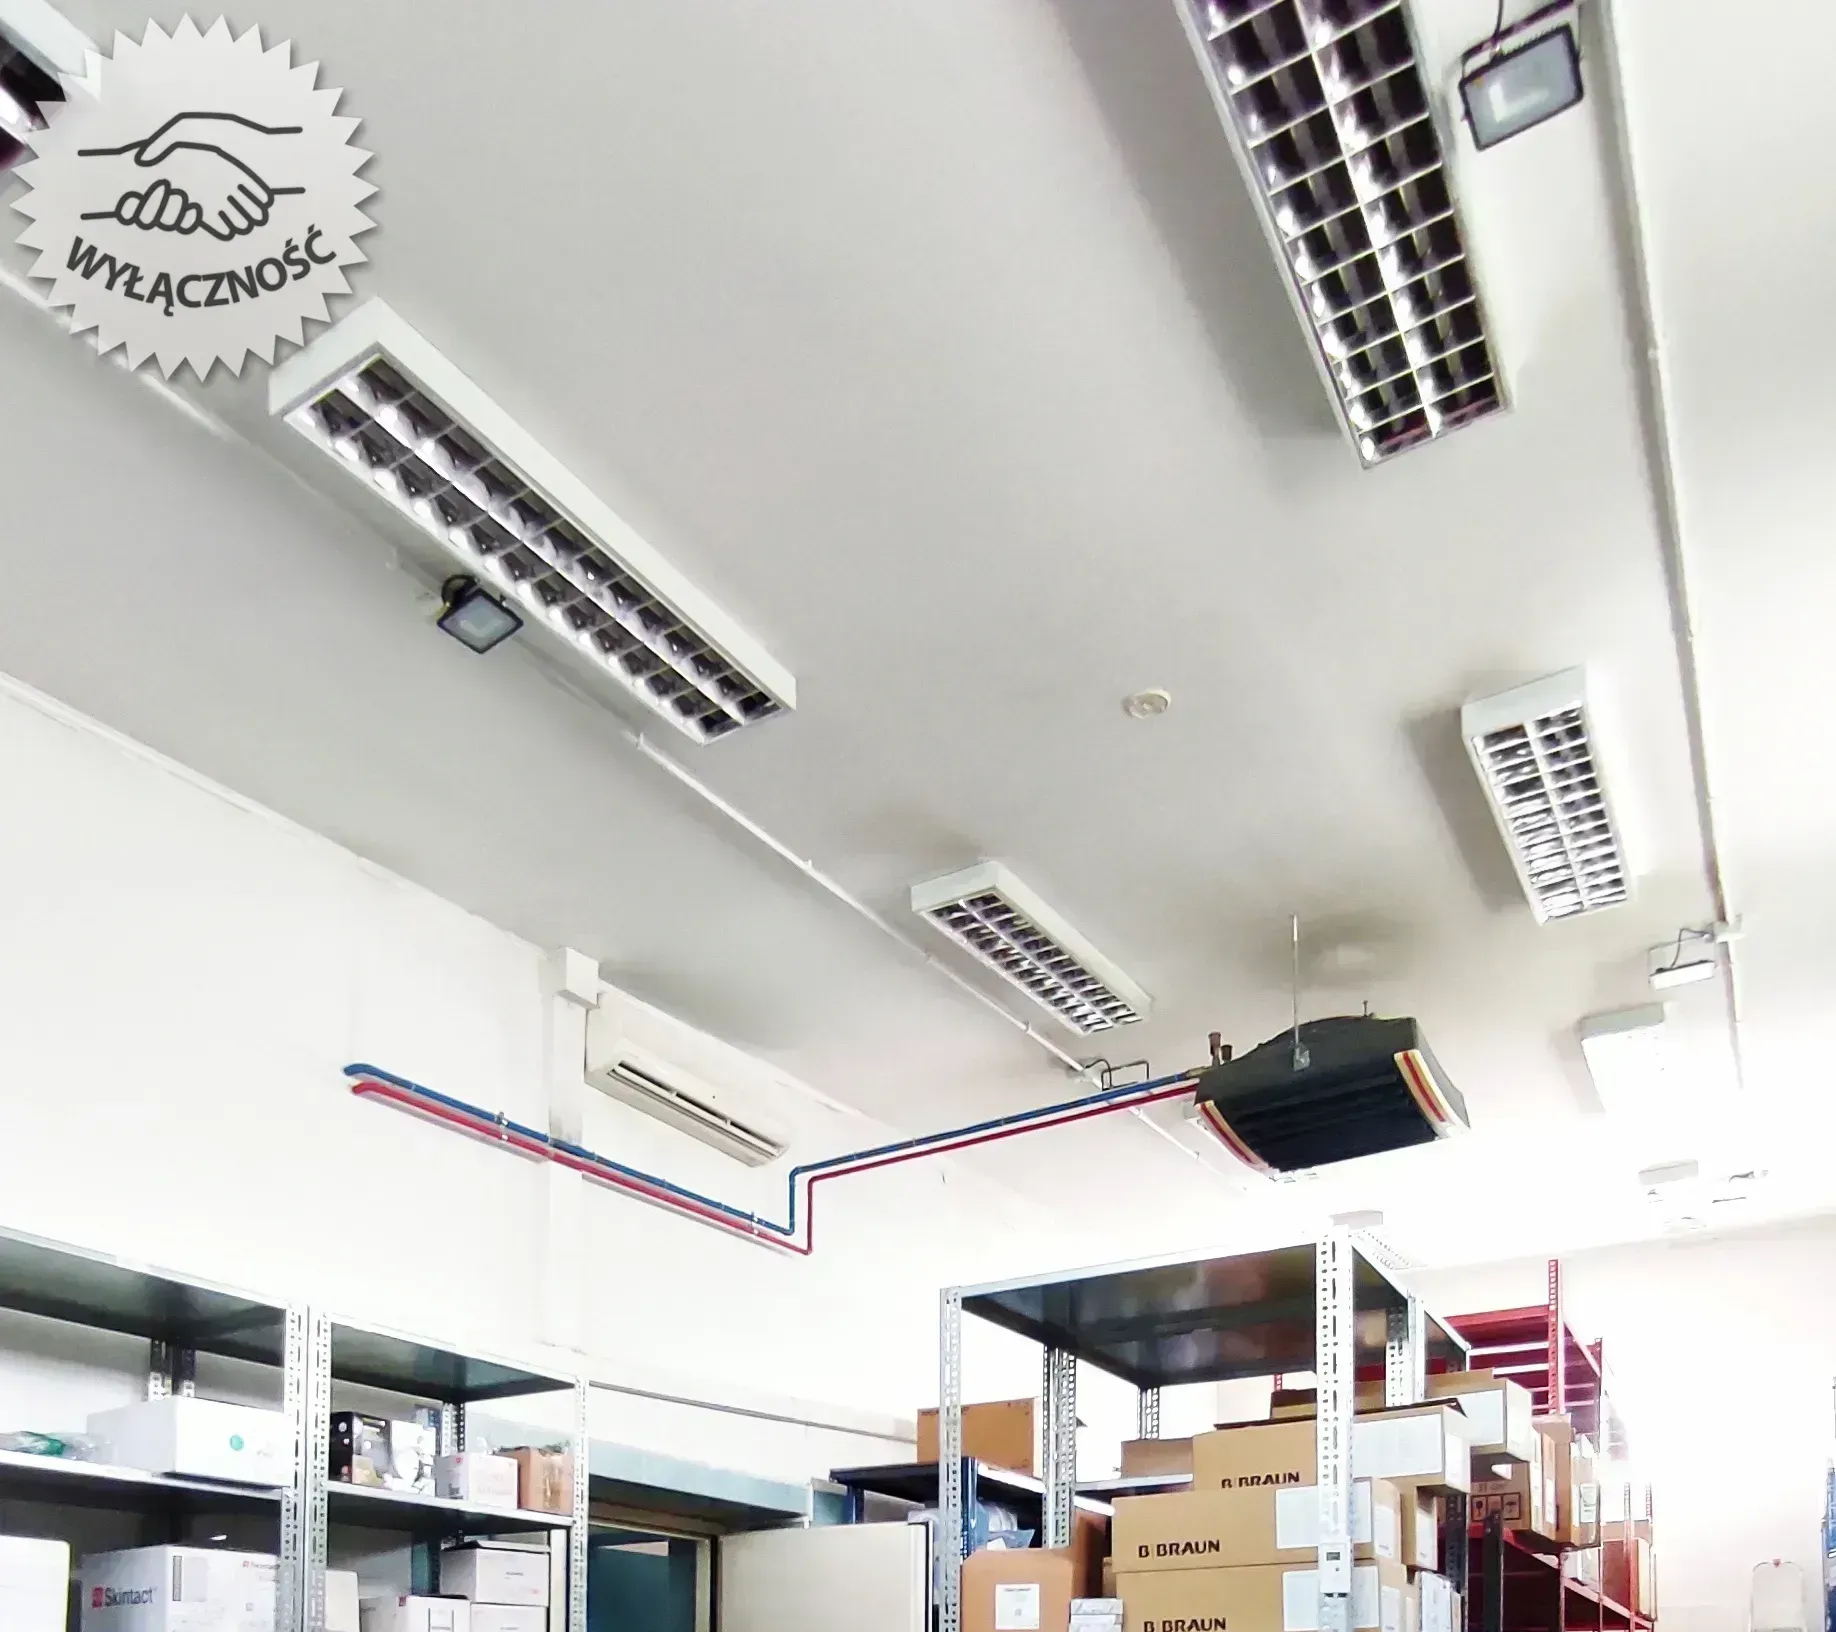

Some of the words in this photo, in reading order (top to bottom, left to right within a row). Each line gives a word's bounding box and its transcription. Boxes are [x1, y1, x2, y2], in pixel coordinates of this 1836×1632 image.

[1238, 1471, 1300, 1488] BRAUN
[1138, 1544, 1150, 1558] B
[1156, 1539, 1221, 1557] BRAUN
[104, 1587, 153, 1607] Skintact
[1161, 1617, 1227, 1632] BRAUN
